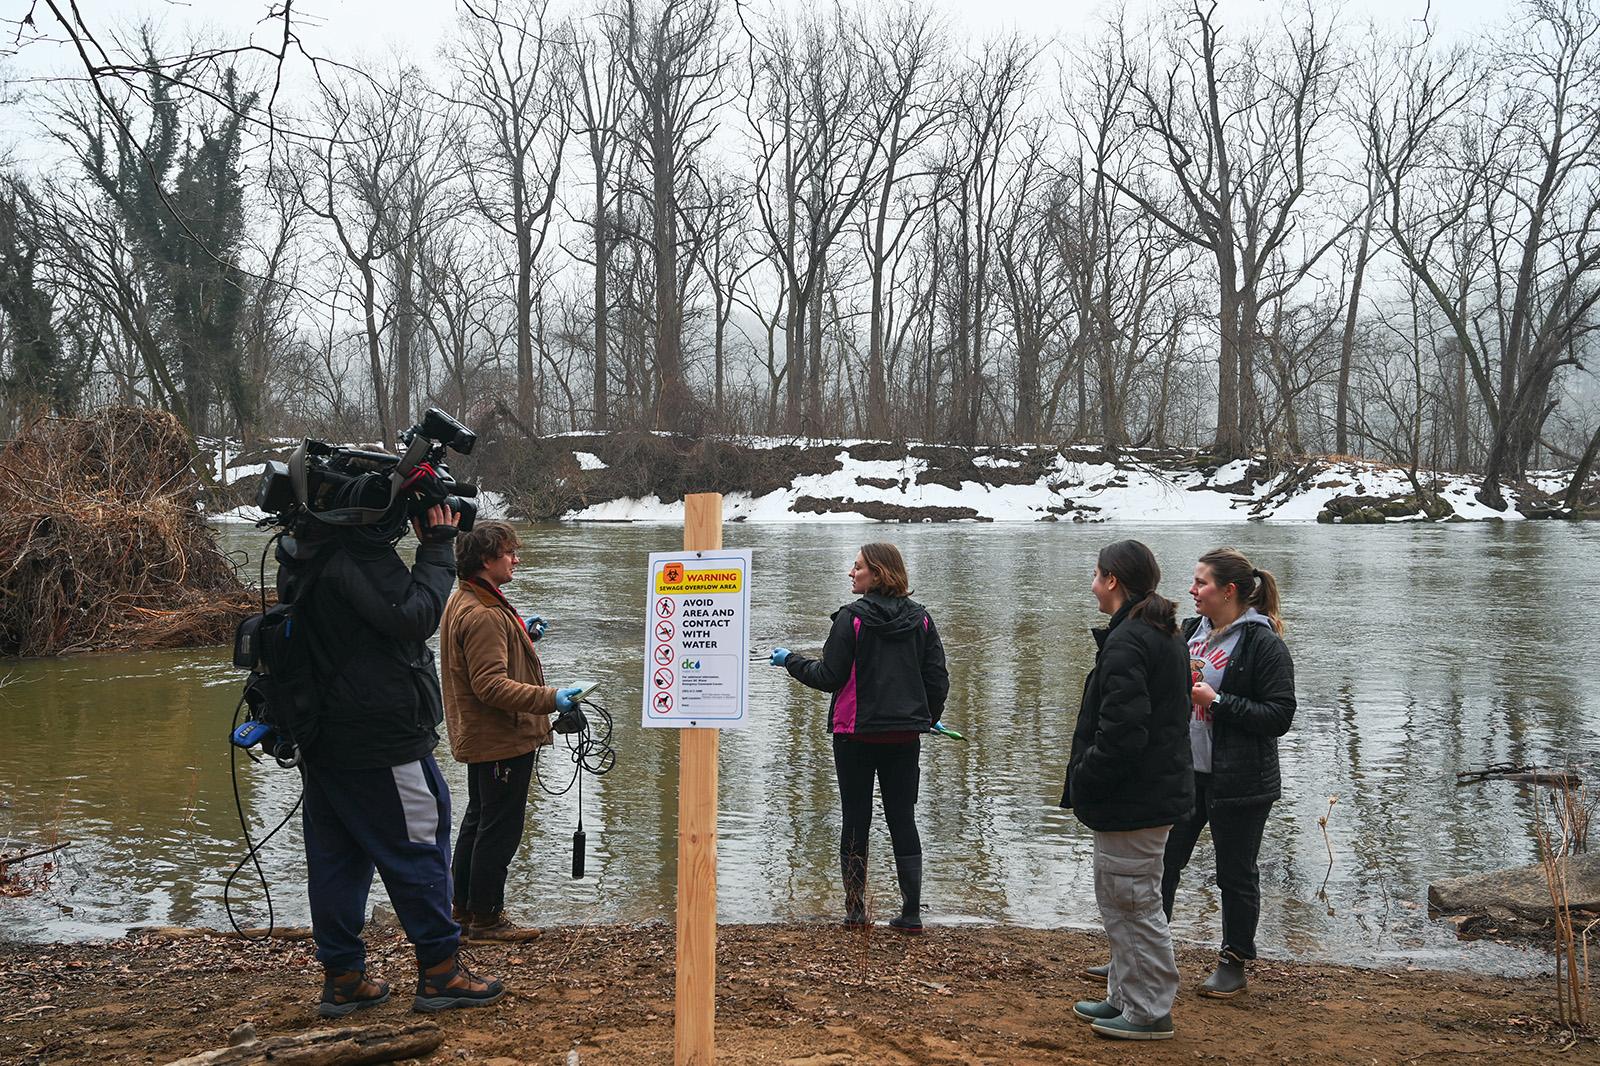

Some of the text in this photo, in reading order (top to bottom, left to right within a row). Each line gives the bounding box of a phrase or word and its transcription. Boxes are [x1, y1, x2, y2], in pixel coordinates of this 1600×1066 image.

[686, 573, 737, 582] WARNING
[682, 599, 714, 607] AVOID
[712, 609, 735, 617] AND
[682, 619, 731, 628] CONTACT
[682, 630, 711, 638] WITH
[682, 640, 718, 649] WATER
